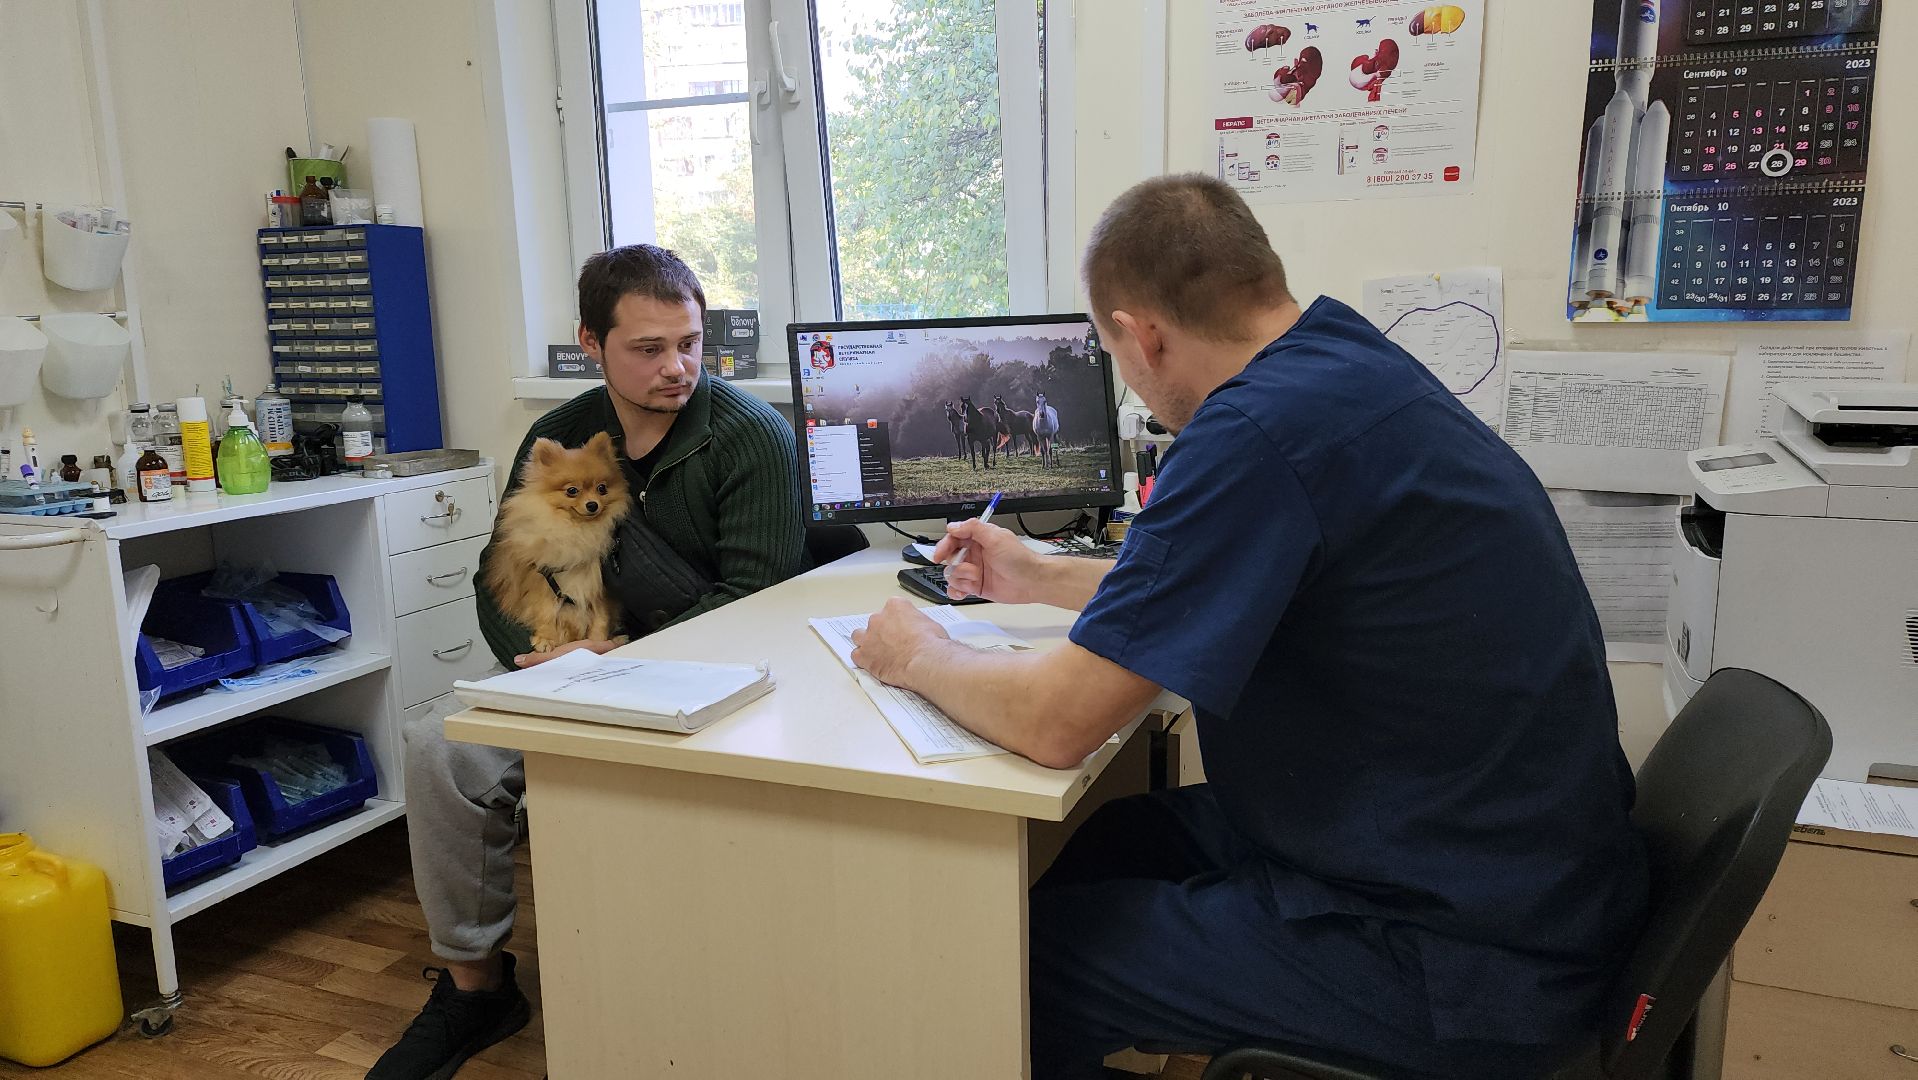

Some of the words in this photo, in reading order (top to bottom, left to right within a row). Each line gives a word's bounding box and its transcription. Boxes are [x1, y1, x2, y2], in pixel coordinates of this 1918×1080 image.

[1684, 70, 1727, 79] Сентябрь
[1735, 68, 1747, 76] 09
[1846, 59, 1871, 68] 2023
[1846, 121, 1858, 129] 17
[1671, 203, 1709, 213] Октябрь
[1833, 198, 1858, 206] 2023
[1686, 293, 1705, 302] 23/30
[1709, 293, 1728, 302] 24/31
[556, 352, 586, 361] BENOVY
